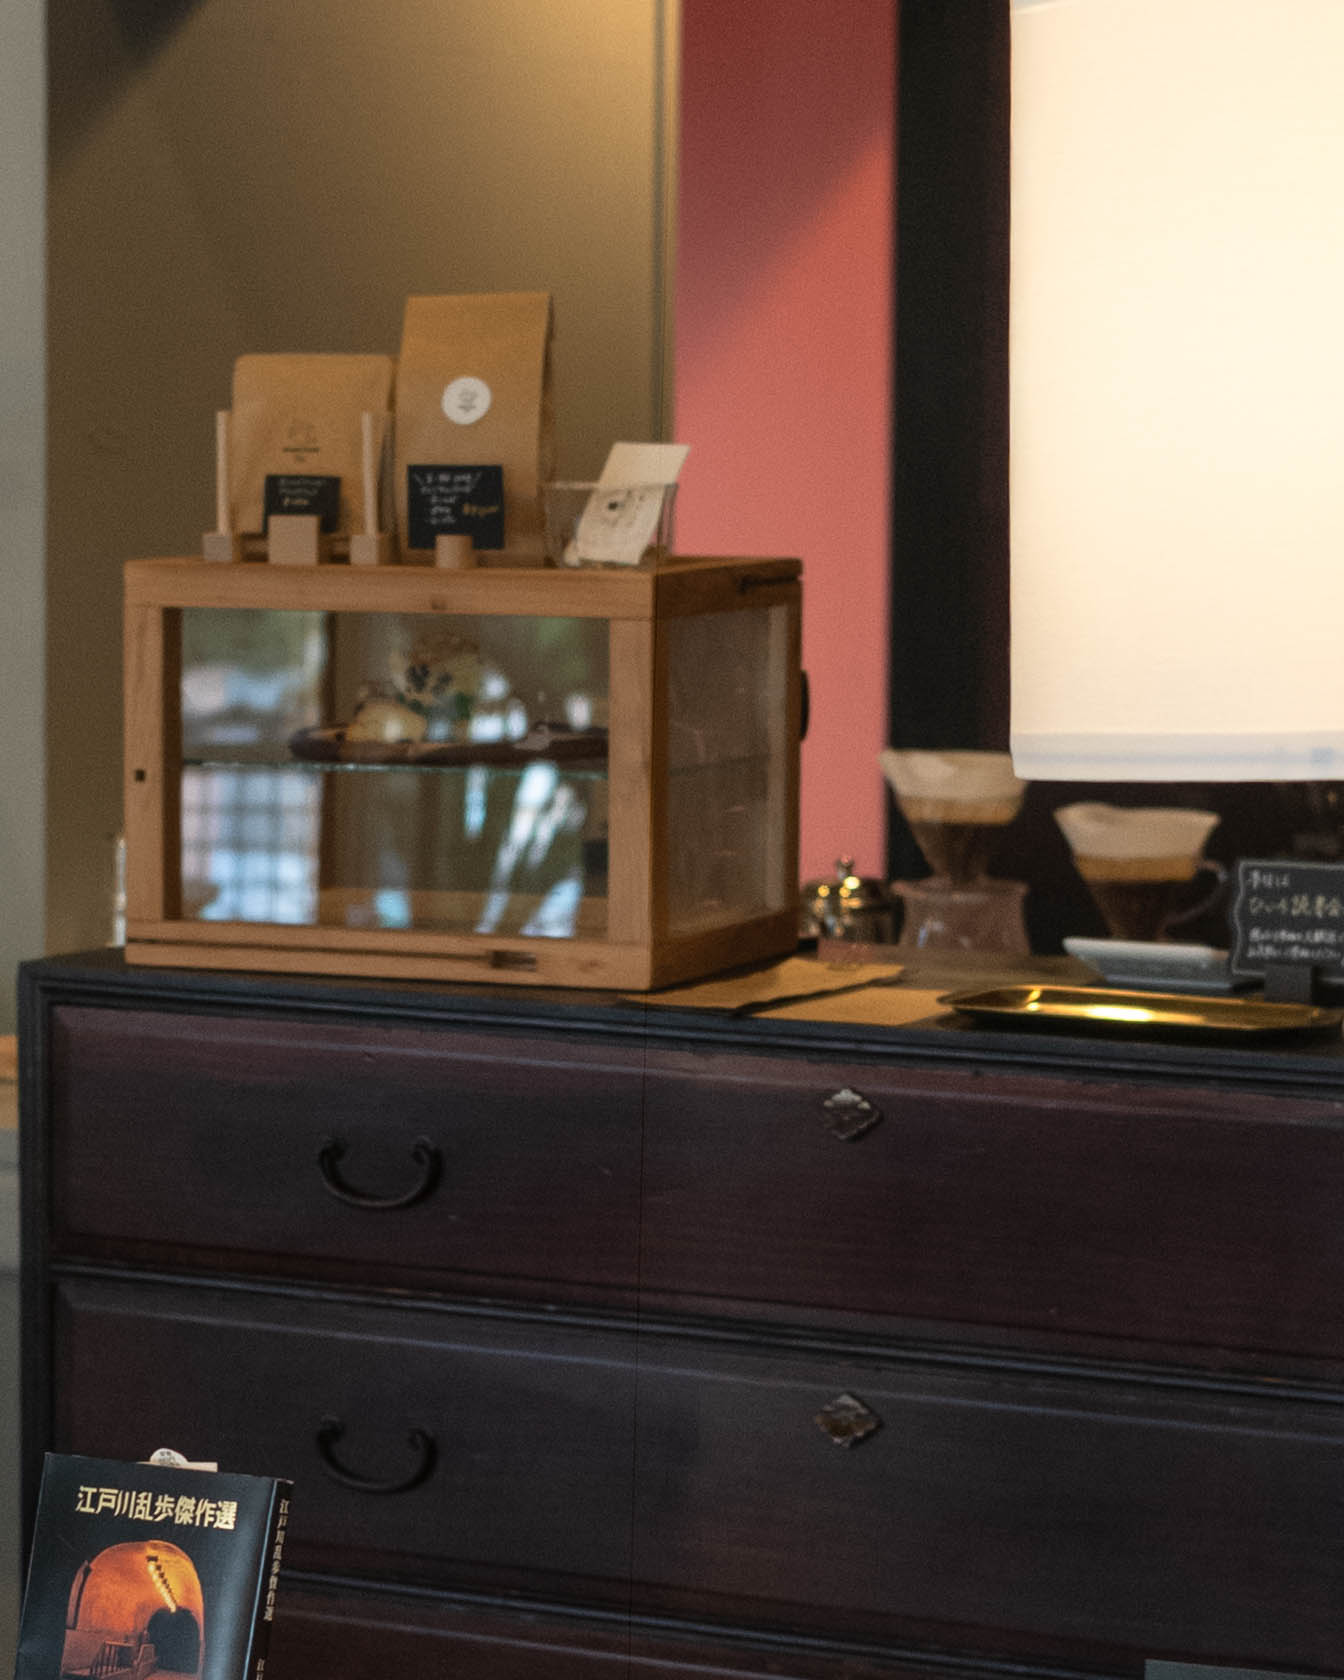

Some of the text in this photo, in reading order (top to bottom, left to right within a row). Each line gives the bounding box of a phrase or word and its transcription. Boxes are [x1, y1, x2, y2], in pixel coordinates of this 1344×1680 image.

[75, 1486, 238, 1530] 江戸川乱歩傑作選
